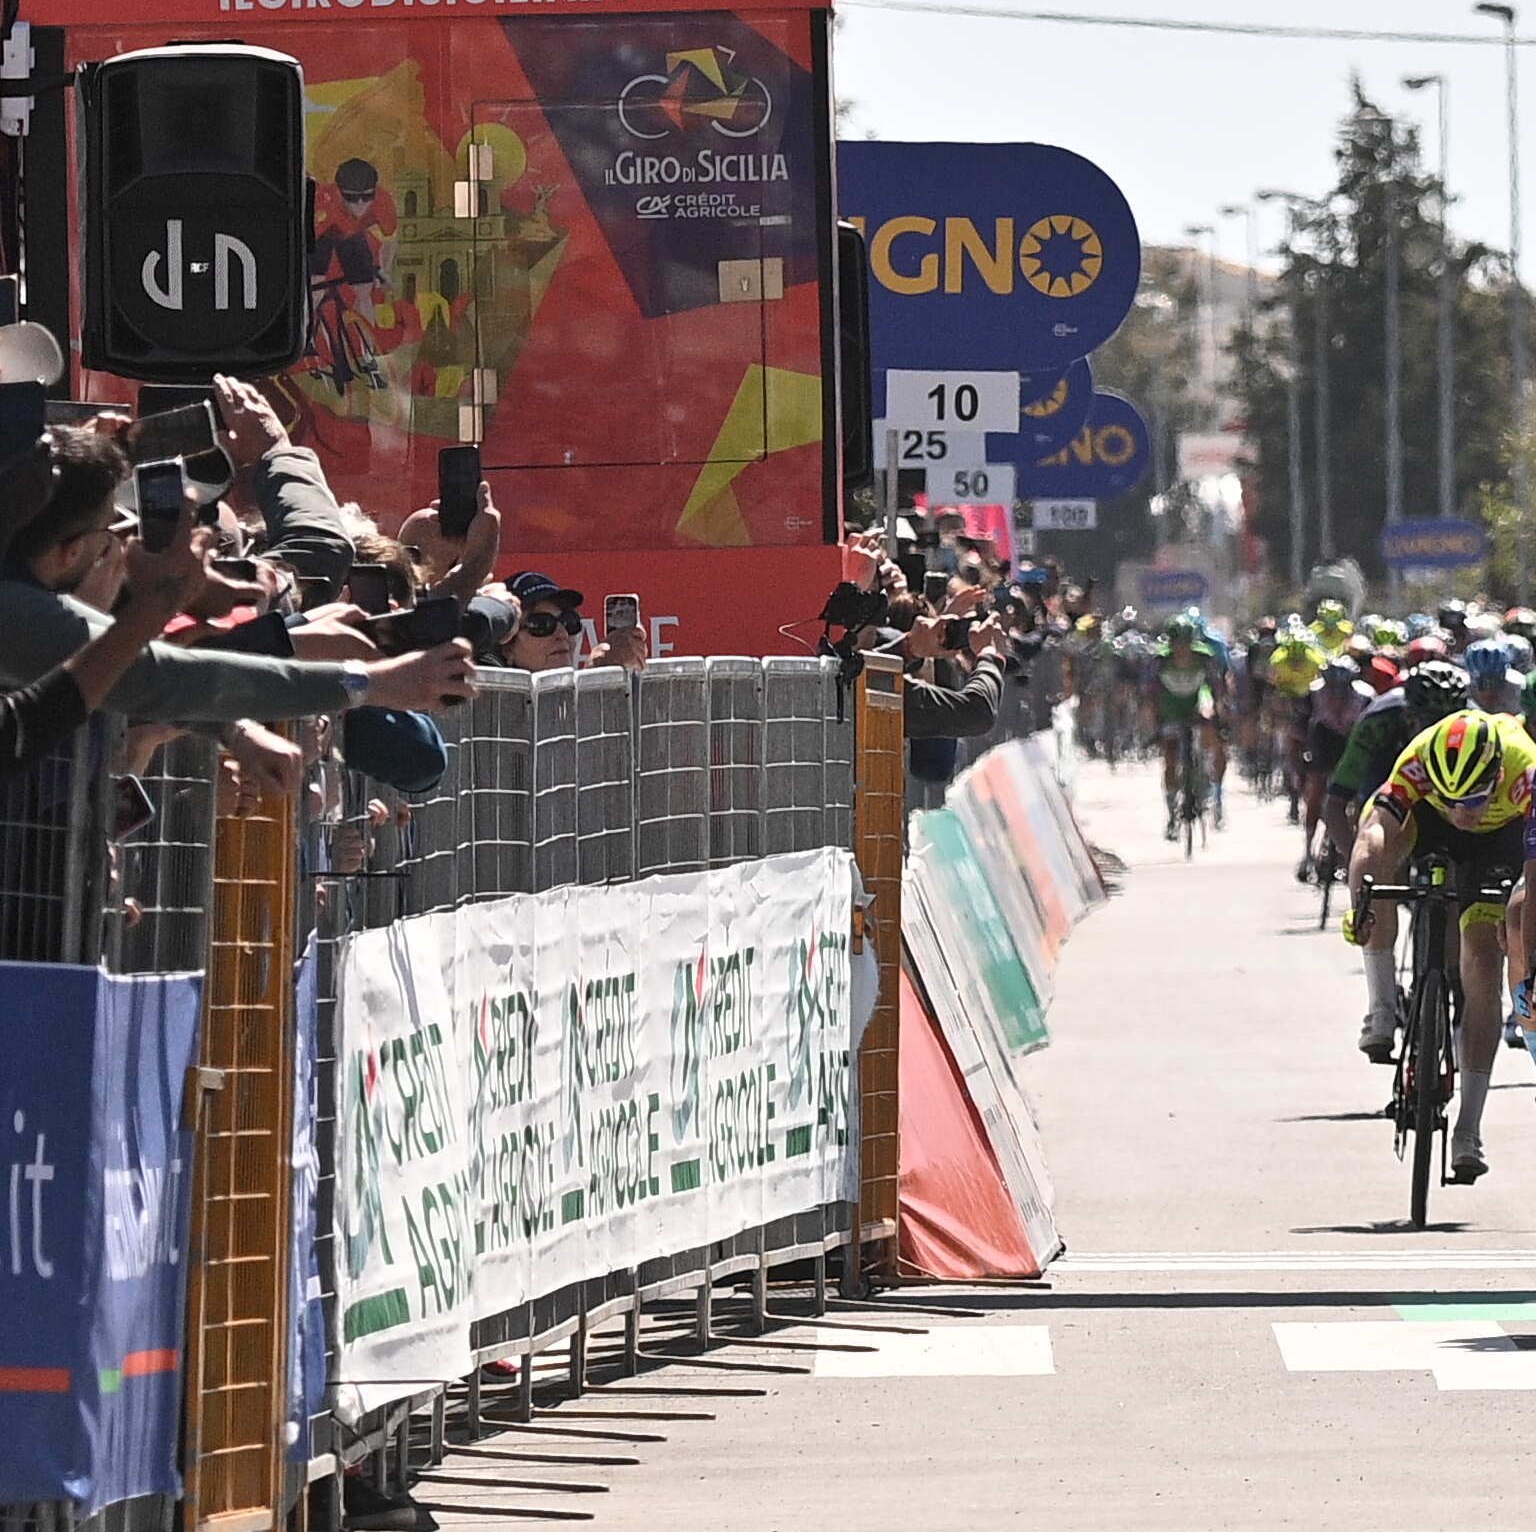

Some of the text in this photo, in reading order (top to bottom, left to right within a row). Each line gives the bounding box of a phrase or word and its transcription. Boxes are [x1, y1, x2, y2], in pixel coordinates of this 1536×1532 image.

[673, 191, 737, 207] CRÉDIT
[674, 204, 762, 219] AGRICOLE
[927, 383, 979, 422] 10
[902, 430, 948, 461] 25
[953, 470, 989, 498] 50
